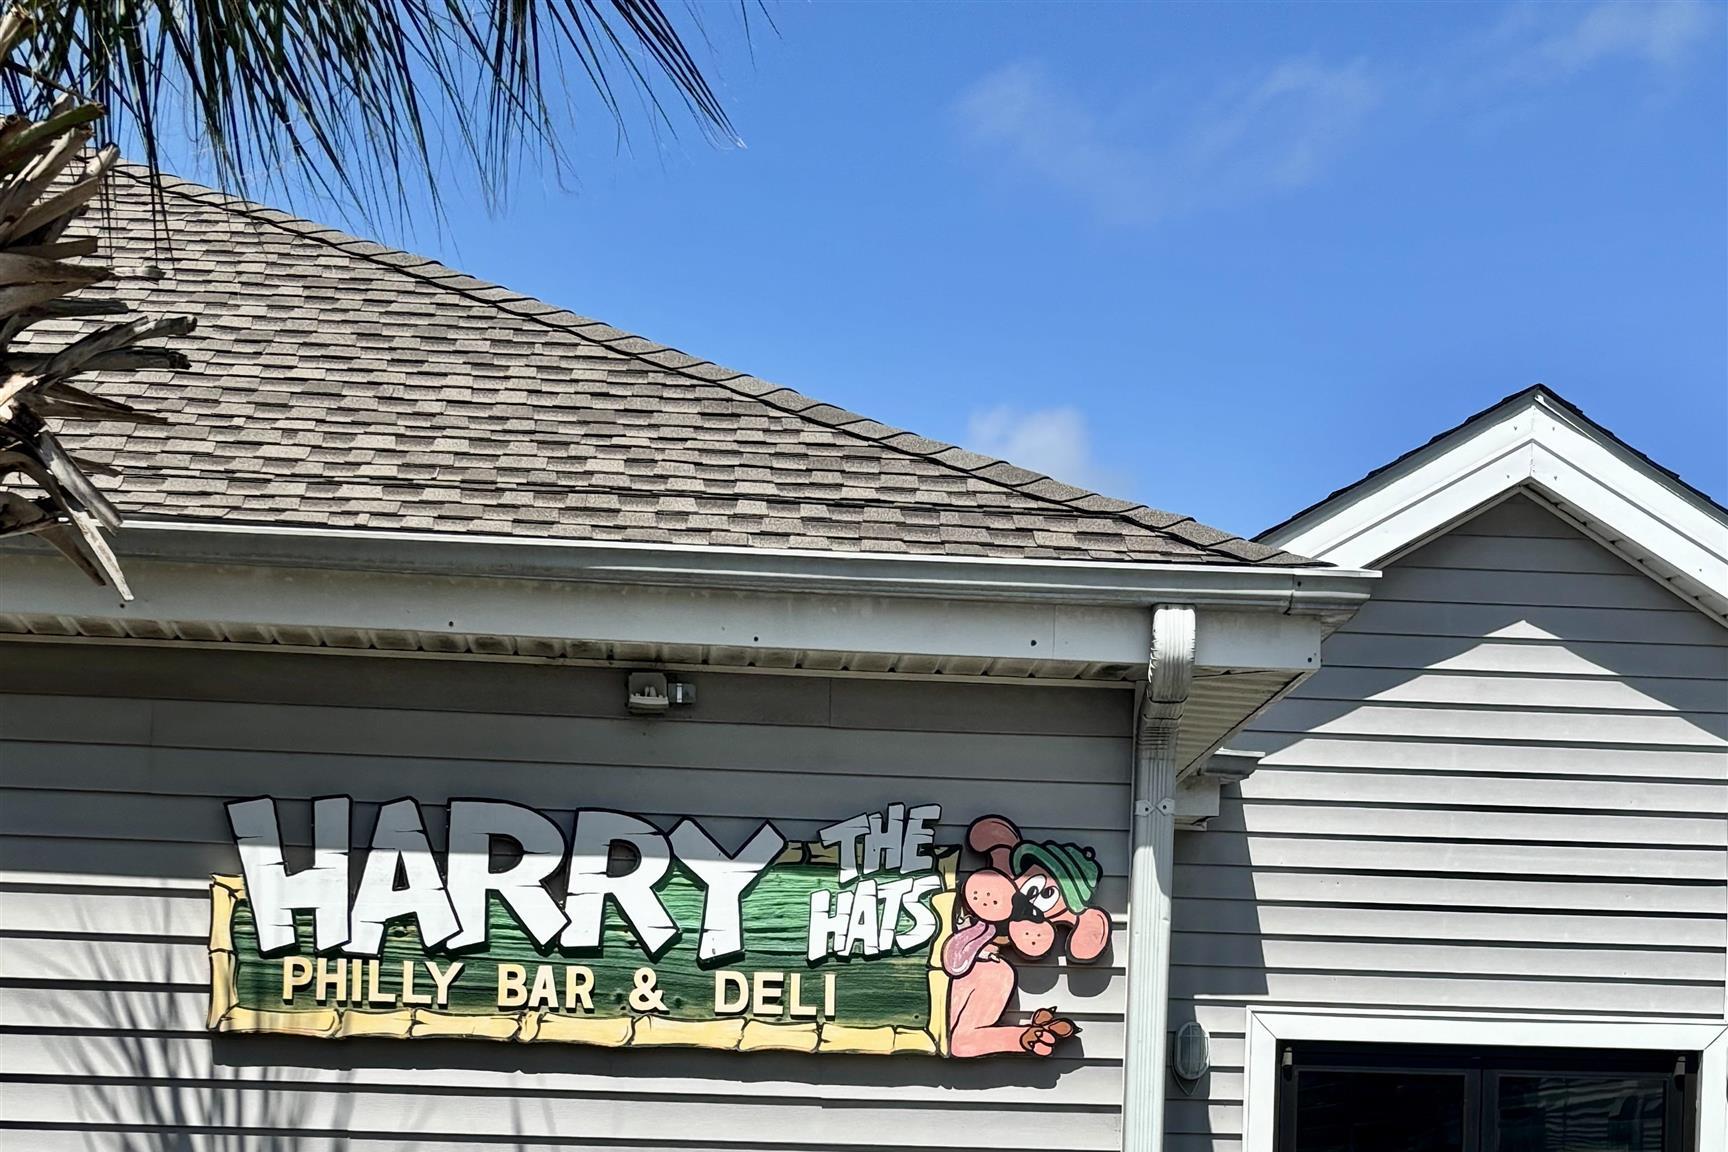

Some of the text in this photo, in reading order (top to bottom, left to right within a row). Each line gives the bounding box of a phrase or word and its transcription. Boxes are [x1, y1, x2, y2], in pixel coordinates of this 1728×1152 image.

[226, 796, 786, 967] HARRY
[819, 803, 942, 883] THE
[807, 875, 943, 964] HATS
[282, 956, 837, 1018] PHILLY BAR & DELI
